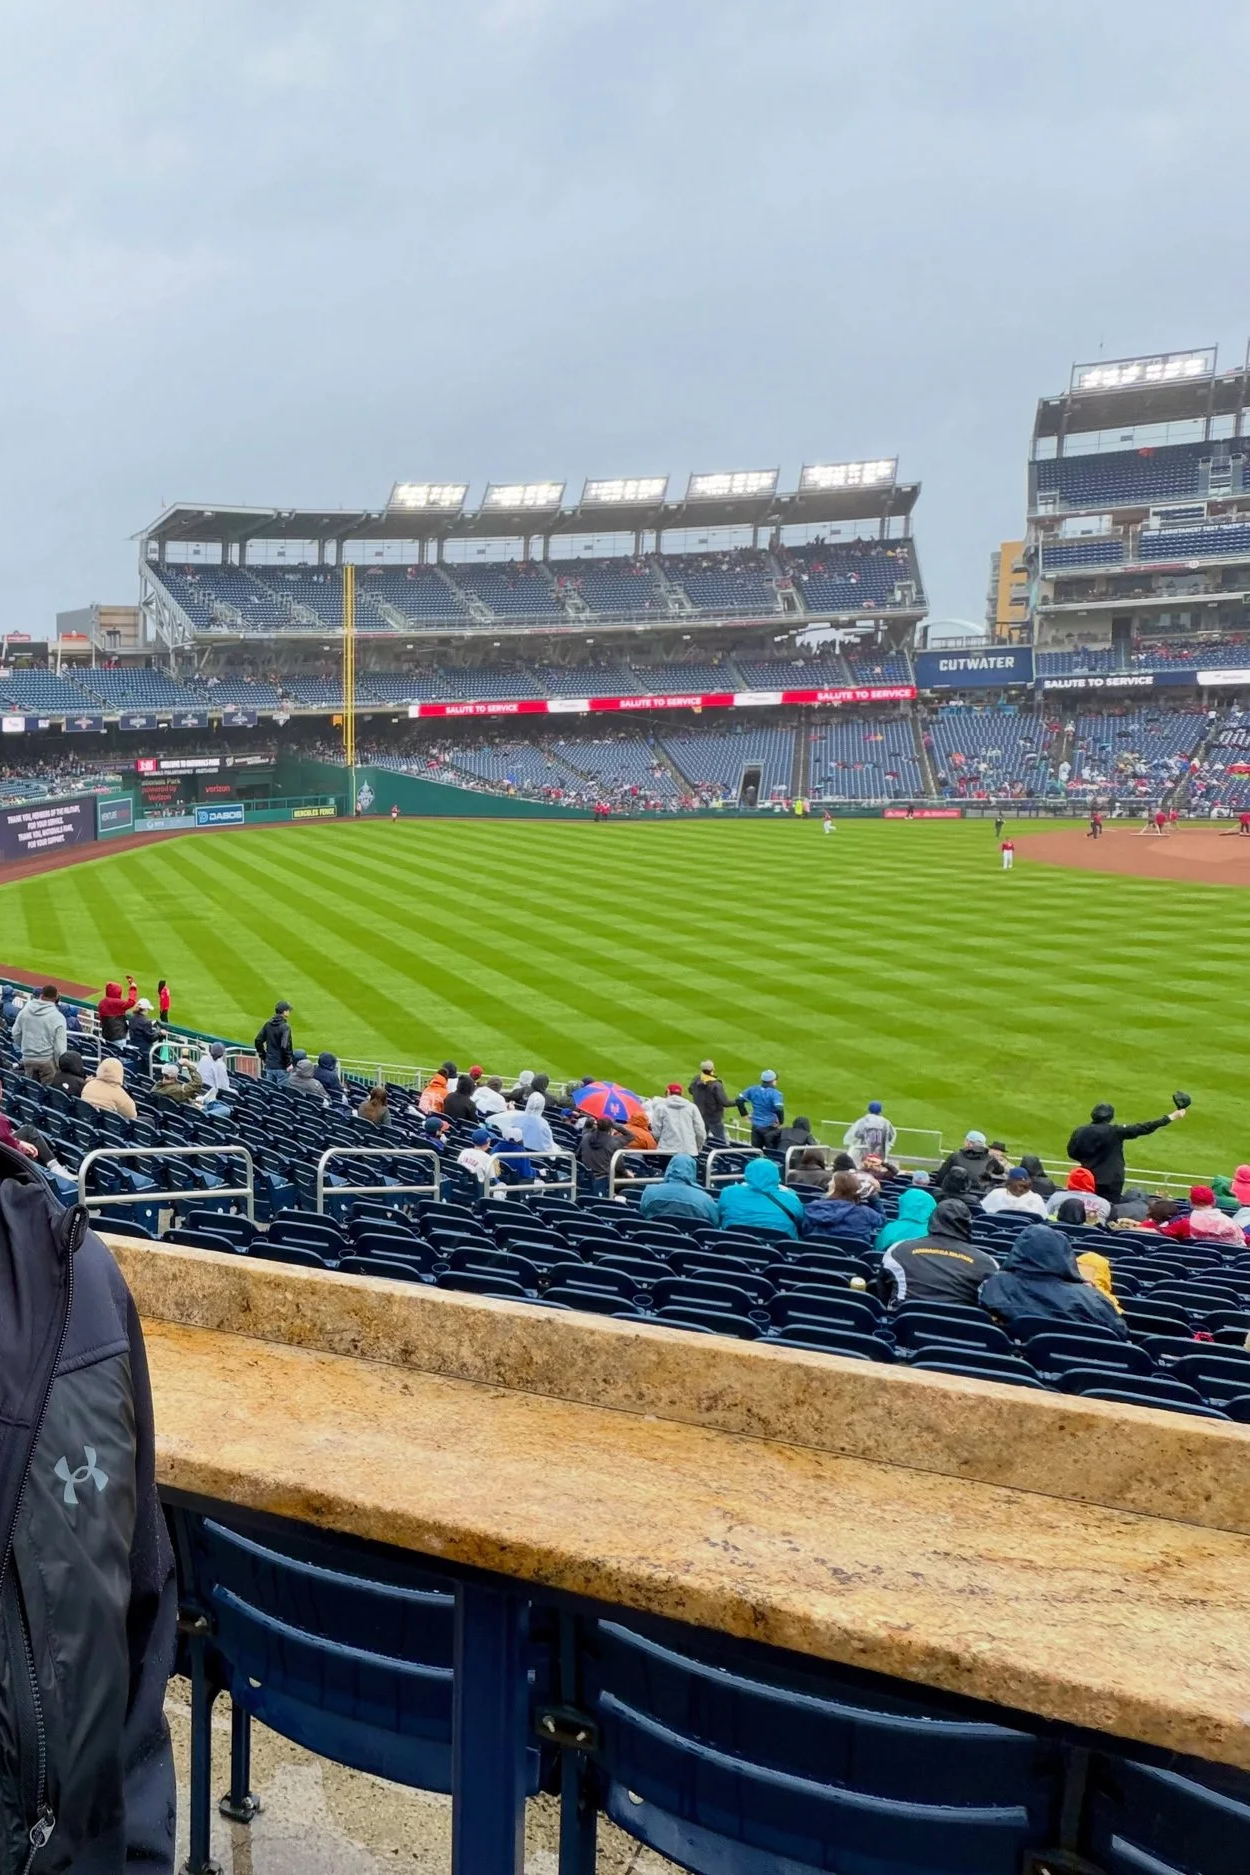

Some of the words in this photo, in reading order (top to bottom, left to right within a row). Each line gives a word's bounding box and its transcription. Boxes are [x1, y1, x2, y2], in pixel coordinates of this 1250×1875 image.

[938, 656, 1015, 672] CUTWATER
[1043, 679, 1087, 689] SALUTE
[1087, 678, 1104, 687] TO
[1105, 675, 1154, 686] SERVICE
[817, 691, 853, 701] SALUTE
[856, 690, 870, 699] TO
[870, 689, 912, 699] SERVICE
[620, 698, 651, 708] SALUTE
[653, 698, 665, 707] TO
[666, 696, 702, 706] SERVICE
[446, 704, 474, 714] SALUTE
[475, 704, 487, 713] TO
[487, 703, 518, 713] SERVICE
[205, 784, 231, 793] verizon
[209, 810, 243, 822] DABOS
[293, 808, 318, 819] HERCULES
[319, 807, 335, 817] FENCE
